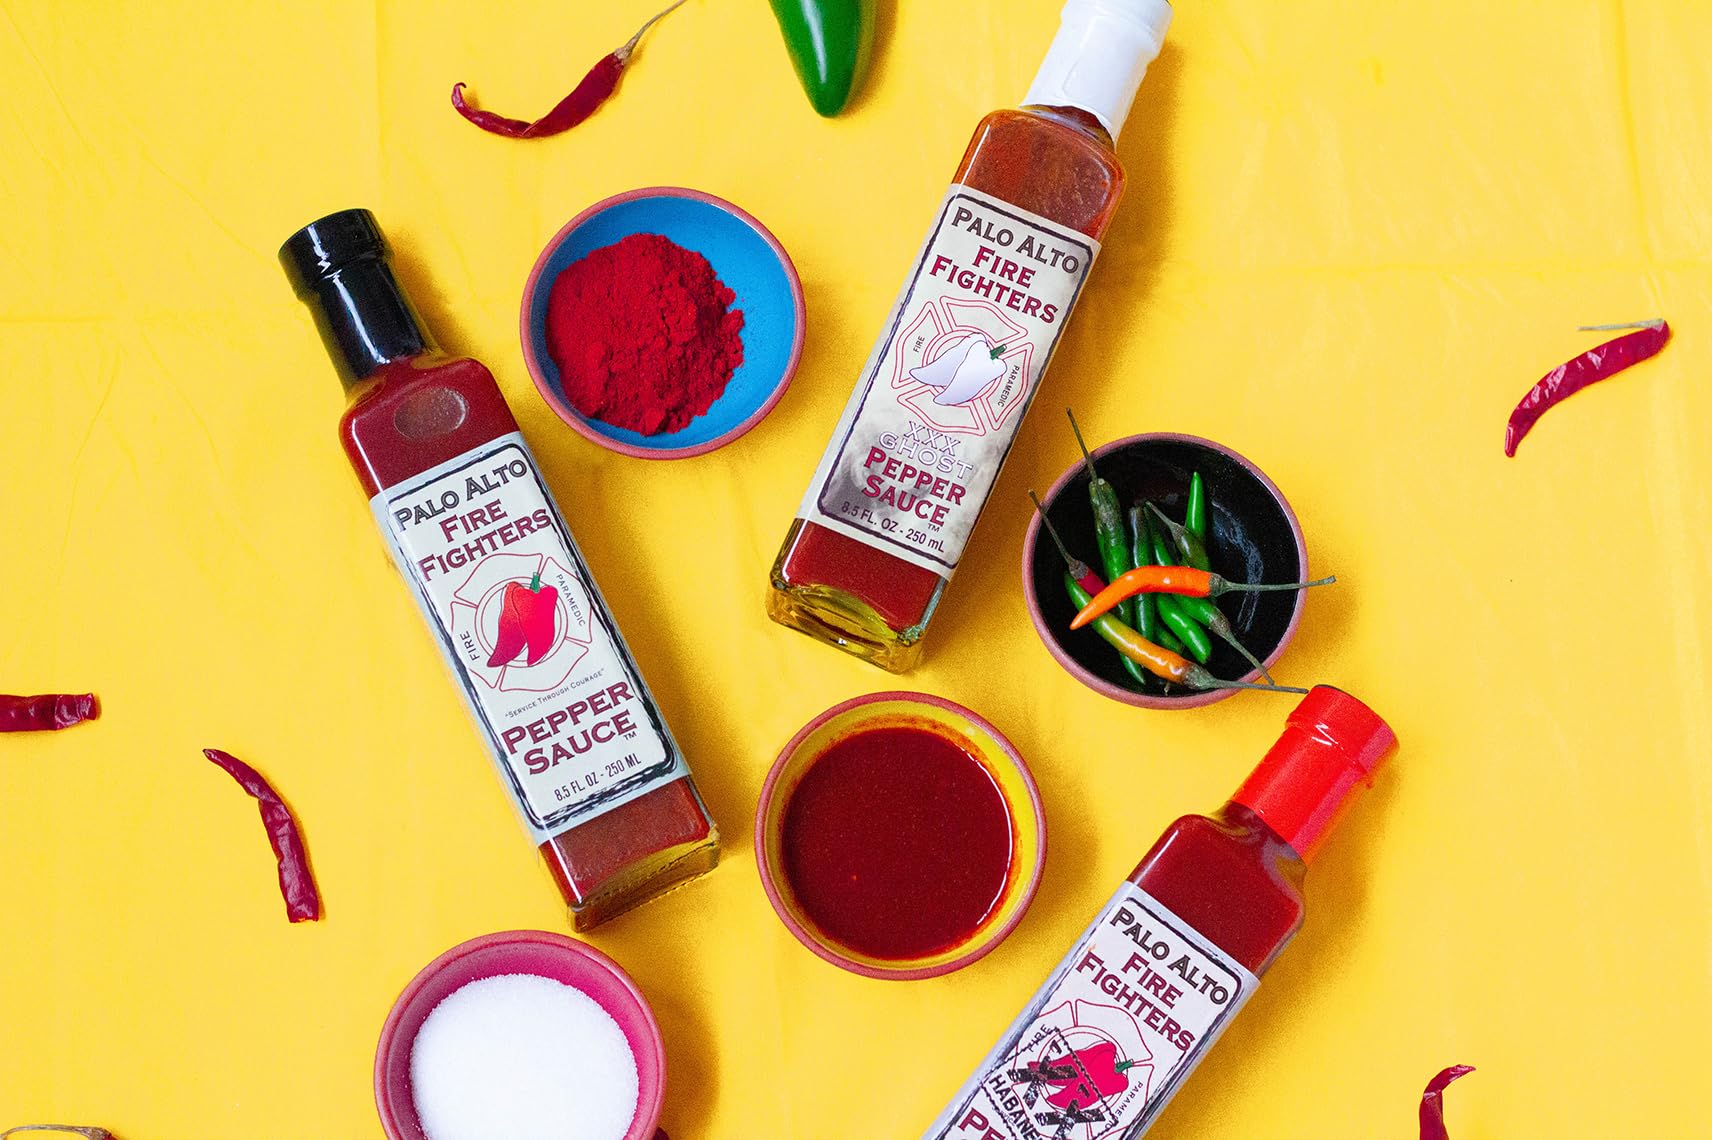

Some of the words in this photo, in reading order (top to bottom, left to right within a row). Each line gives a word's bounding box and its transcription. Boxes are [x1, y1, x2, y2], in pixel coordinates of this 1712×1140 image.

[951, 206, 1014, 247] PALO
[1016, 234, 1079, 274] ALTO
[929, 254, 1059, 324] FIGHTERS
[972, 245, 1036, 289] FIRE
[913, 335, 925, 353] FIRE
[997, 365, 1020, 408] PARAMEDIC
[878, 431, 973, 480] GHOST
[904, 421, 961, 457] XXX
[393, 491, 461, 533] PALO
[465, 459, 527, 501] ALTO
[861, 474, 950, 527] SAUCE
[863, 446, 967, 506] PEPPER
[418, 509, 551, 582] FIGHTERS
[439, 499, 508, 543] FIRE
[840, 501, 859, 517] 8.5
[861, 509, 878, 526] FL.
[880, 518, 899, 533] OZ
[905, 528, 926, 545] 250
[927, 537, 945, 553] mL
[557, 574, 586, 627] PARAMEDIC
[459, 630, 480, 661] FIRE
[501, 682, 634, 755] PEPPER
[523, 709, 637, 775] SAUCE
[554, 785, 572, 802] 8.5
[585, 772, 600, 788] OZ
[604, 759, 624, 779] 250
[625, 753, 642, 768] ML
[1109, 906, 1170, 961] PALO
[1167, 954, 1229, 1005] ALTO
[1121, 951, 1184, 1010] FIRE
[1075, 951, 1196, 1051] FIGHTERS
